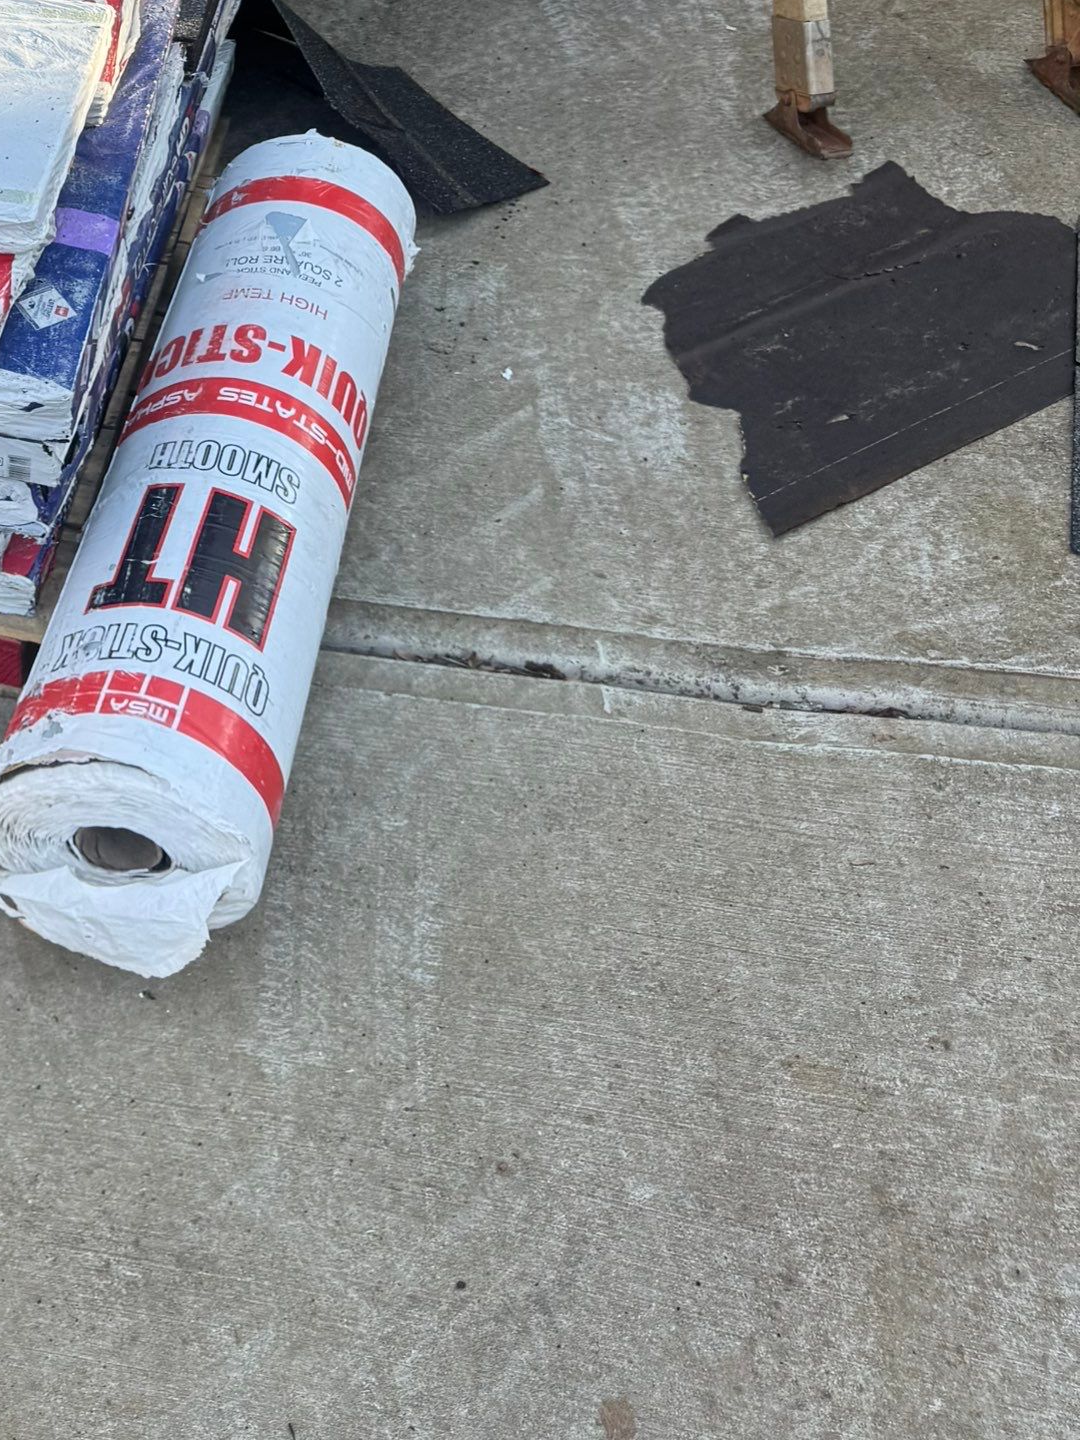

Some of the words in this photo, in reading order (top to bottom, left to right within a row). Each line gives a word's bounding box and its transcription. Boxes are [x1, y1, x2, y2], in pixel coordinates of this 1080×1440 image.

[269, 266, 292, 276] AND
[334, 275, 344, 288] 2
[279, 291, 330, 320] HIGH
[151, 439, 301, 505] SMOOTH
[84, 482, 297, 652] HT
